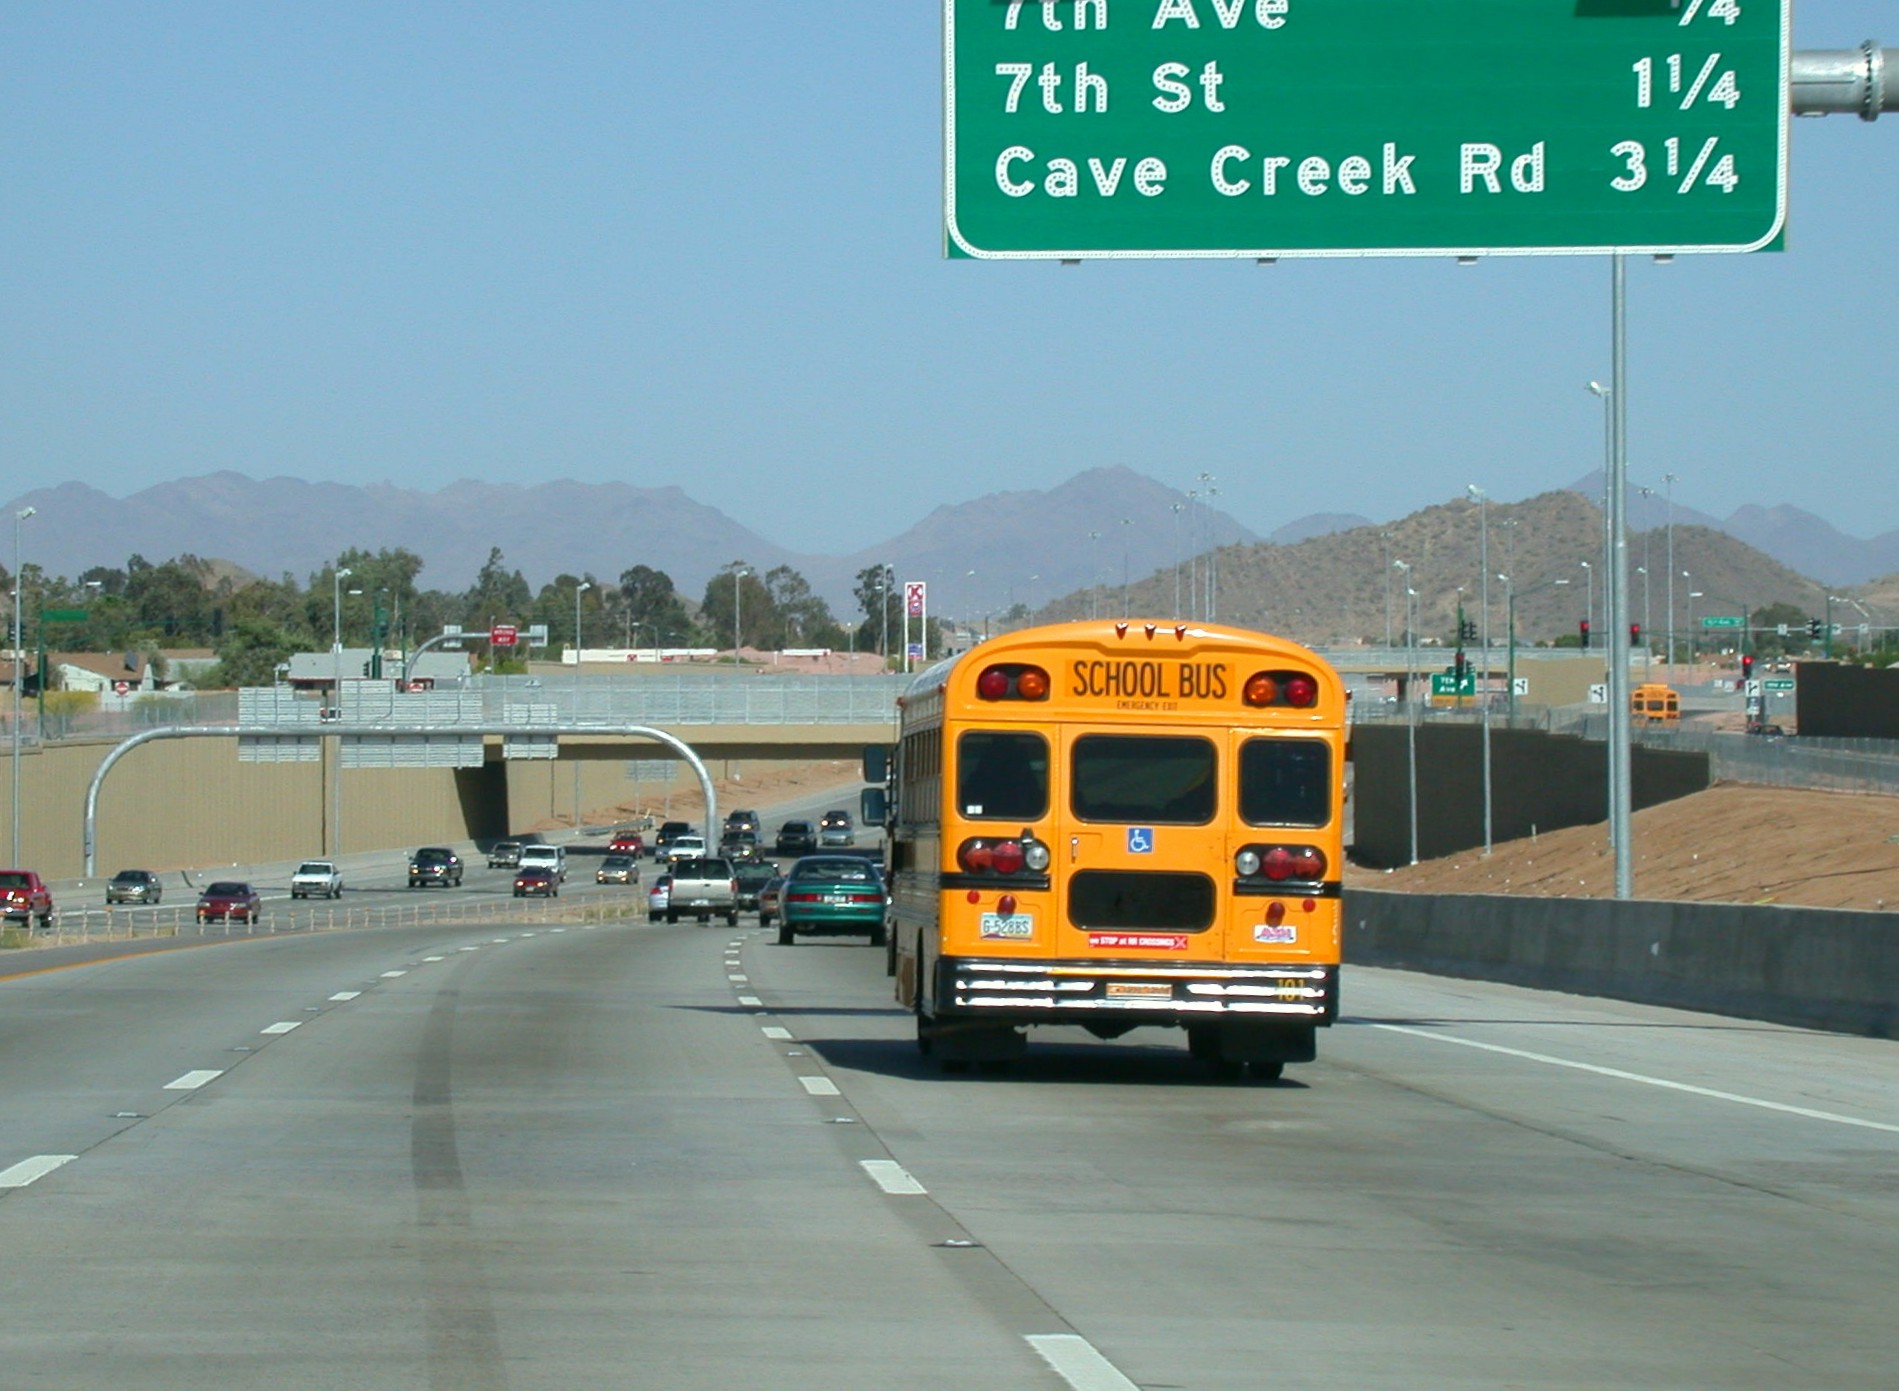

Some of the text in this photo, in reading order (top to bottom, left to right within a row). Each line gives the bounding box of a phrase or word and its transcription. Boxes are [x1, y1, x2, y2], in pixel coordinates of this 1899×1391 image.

[1151, 0, 1290, 29] Ave
[995, 61, 1108, 114] 7th
[1152, 60, 1226, 114] St
[995, 145, 1167, 198] Cave
[1210, 142, 1416, 196] Creek
[1460, 142, 1545, 194] Rd
[1073, 660, 1227, 699] SCHOOL BUS
